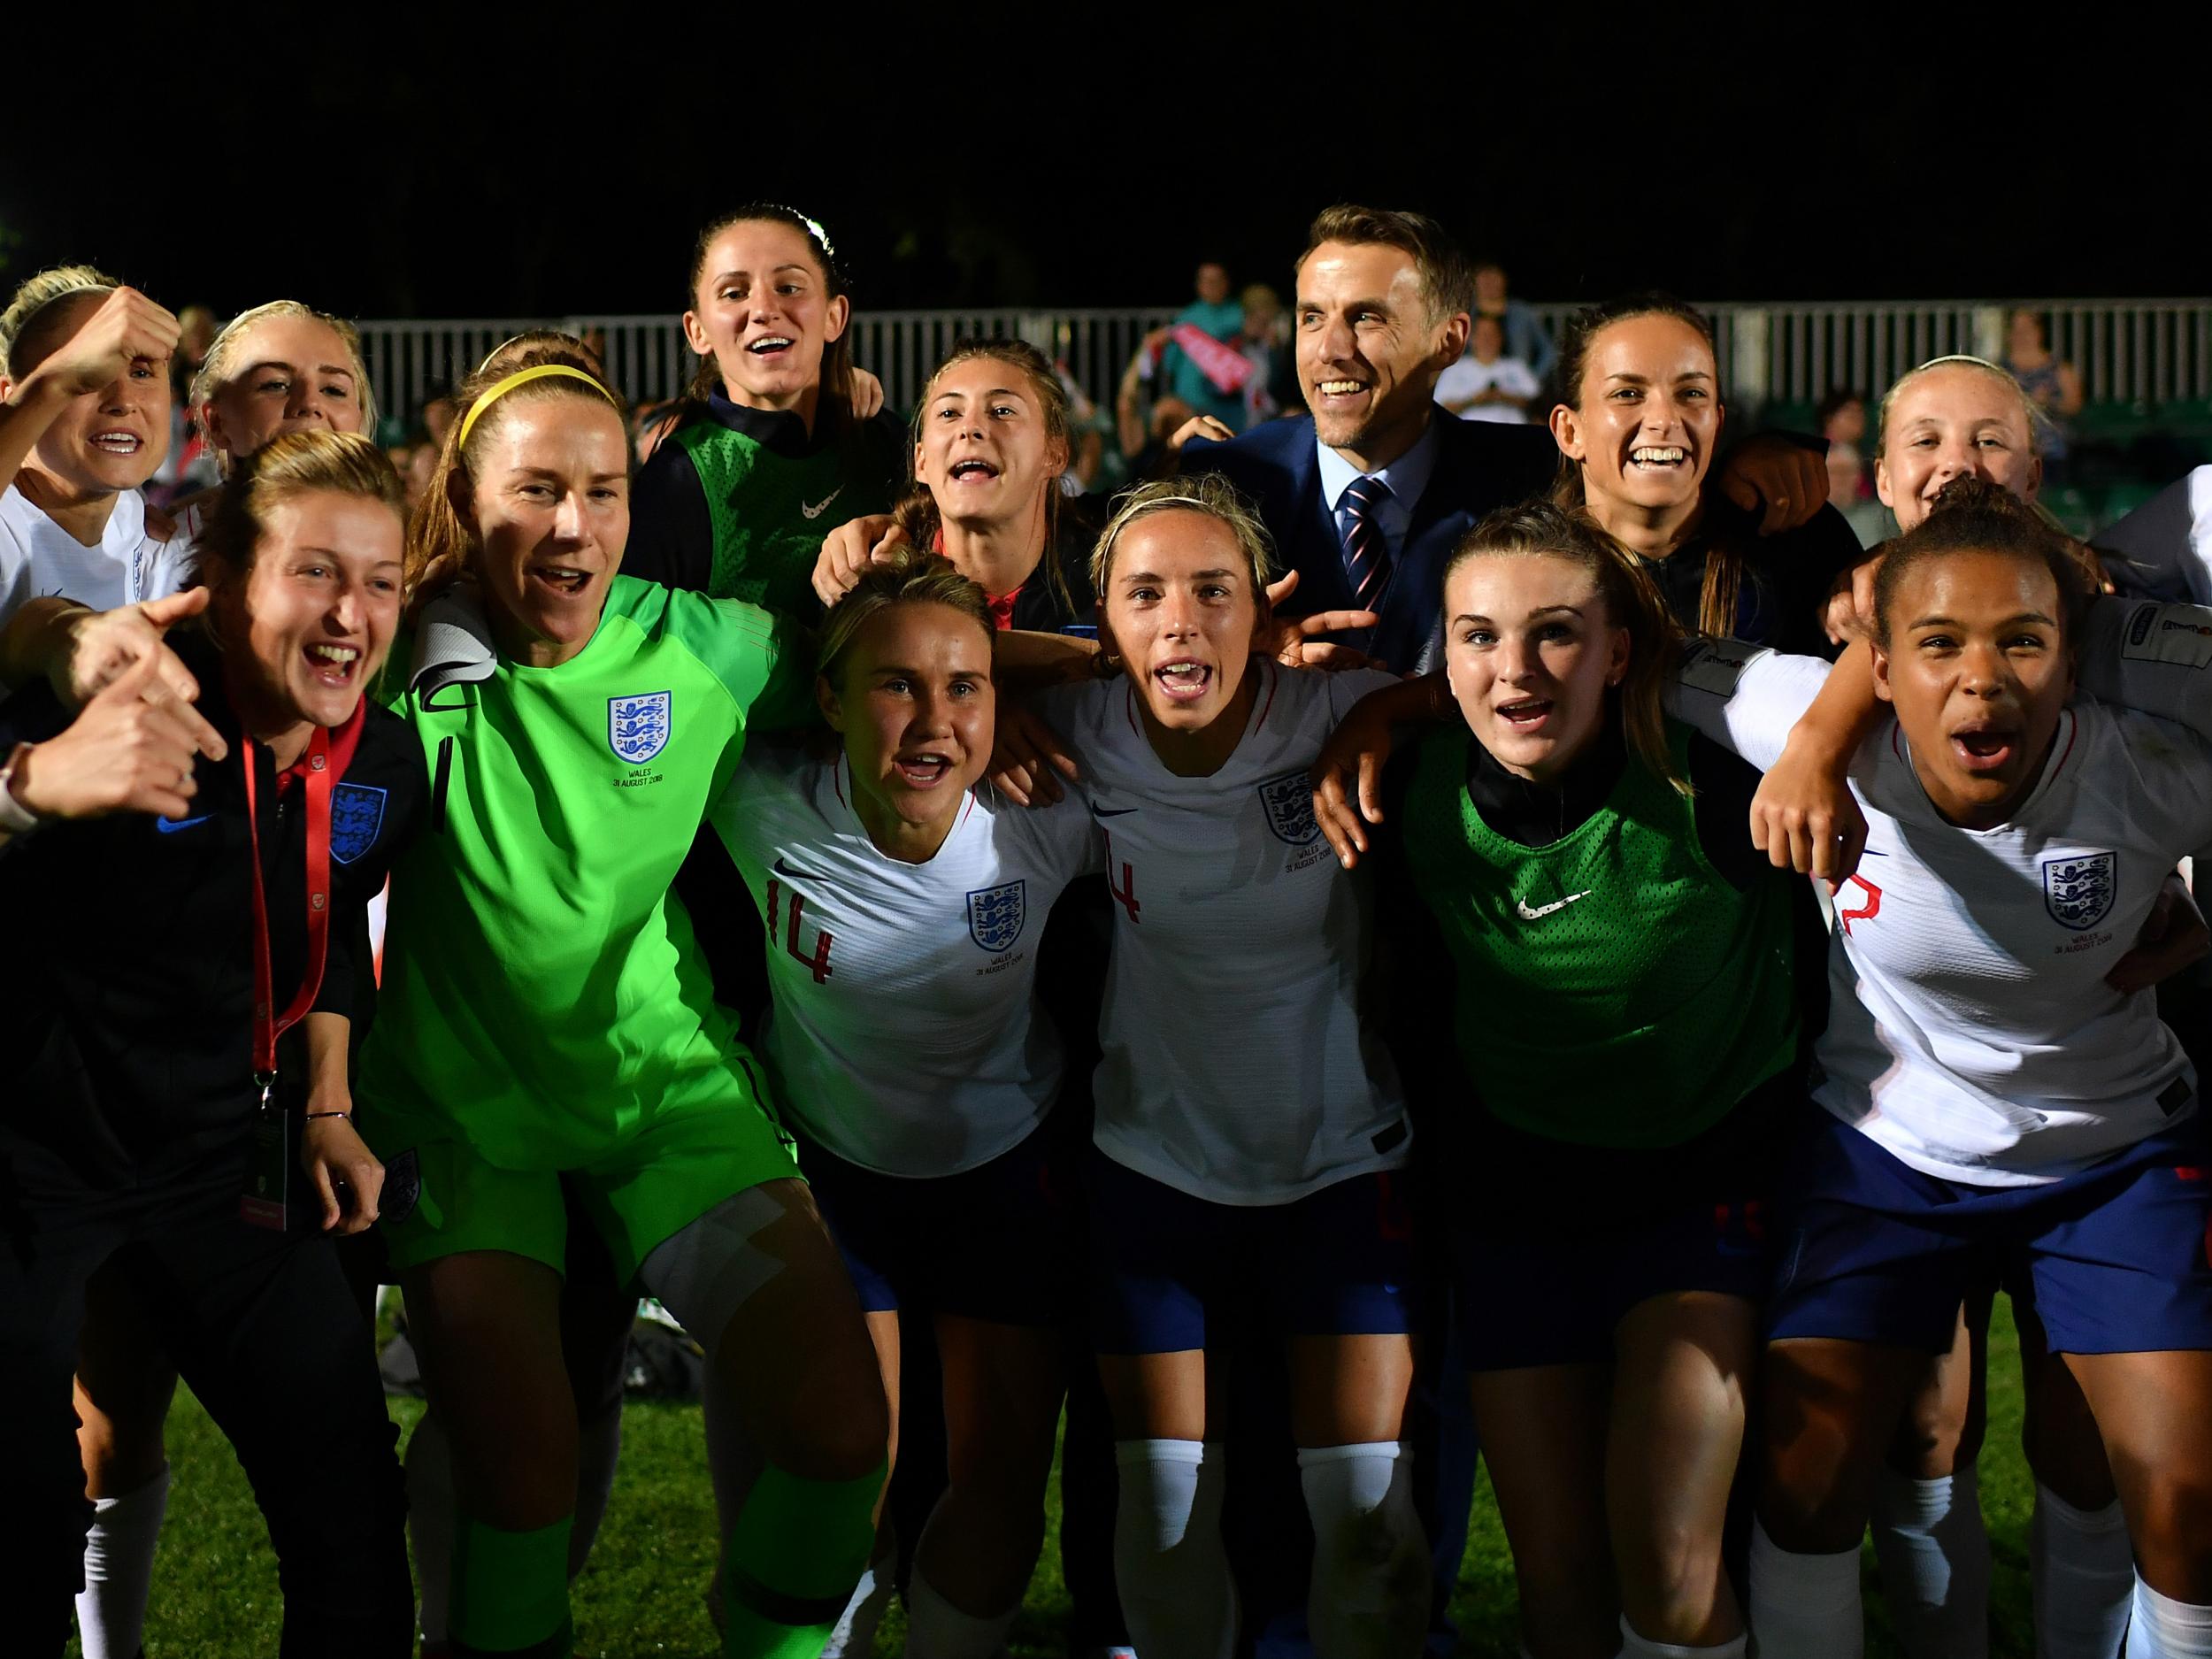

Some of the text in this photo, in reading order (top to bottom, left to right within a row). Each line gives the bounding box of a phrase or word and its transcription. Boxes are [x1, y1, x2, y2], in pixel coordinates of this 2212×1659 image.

[612, 773, 663, 787] 31 AUGUST 2018
[628, 768, 652, 779] WALES
[1296, 844, 1319, 859] WALES
[1294, 855, 1317, 872] AUGUST
[766, 879, 833, 986] 14
[2070, 933, 2098, 944] WALES
[990, 952, 1012, 965] WALES
[985, 961, 1010, 974] AUGUST
